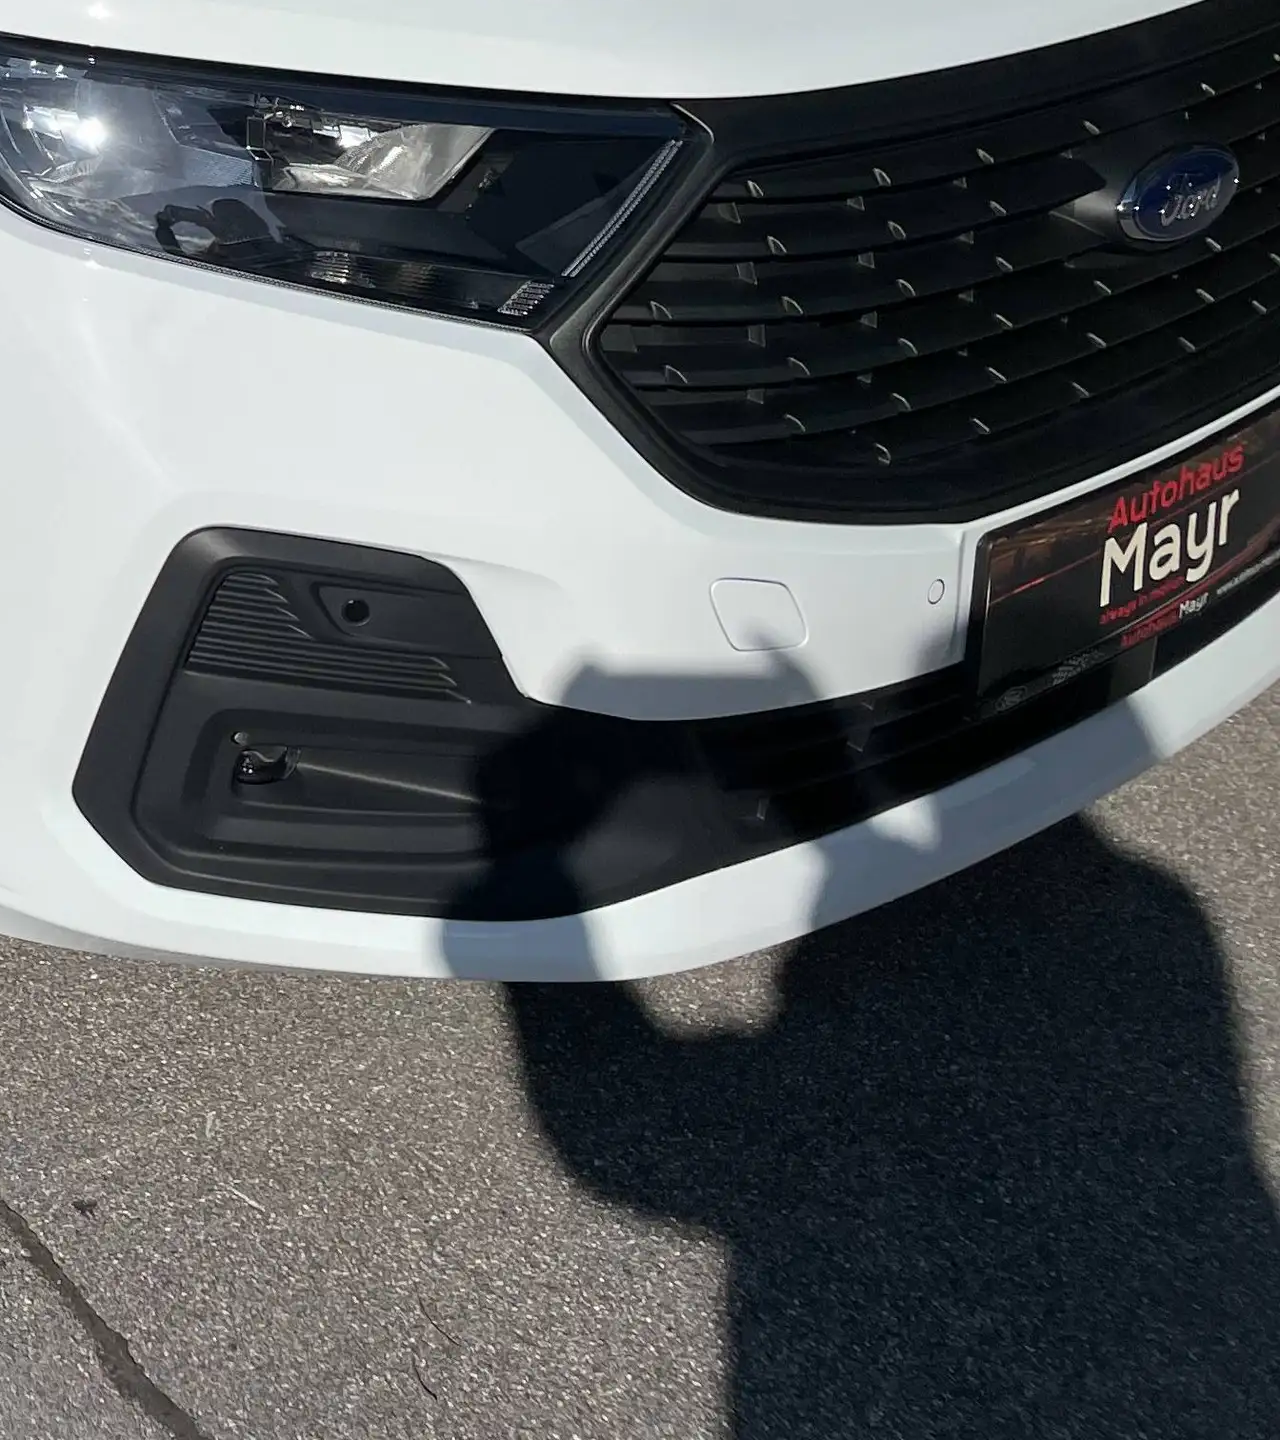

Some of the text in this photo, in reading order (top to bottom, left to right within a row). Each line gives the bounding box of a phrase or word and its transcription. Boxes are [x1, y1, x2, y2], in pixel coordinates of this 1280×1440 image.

[1161, 172, 1221, 227] Ford
[1107, 446, 1245, 534] Autohaus
[1099, 489, 1240, 608] Mayr
